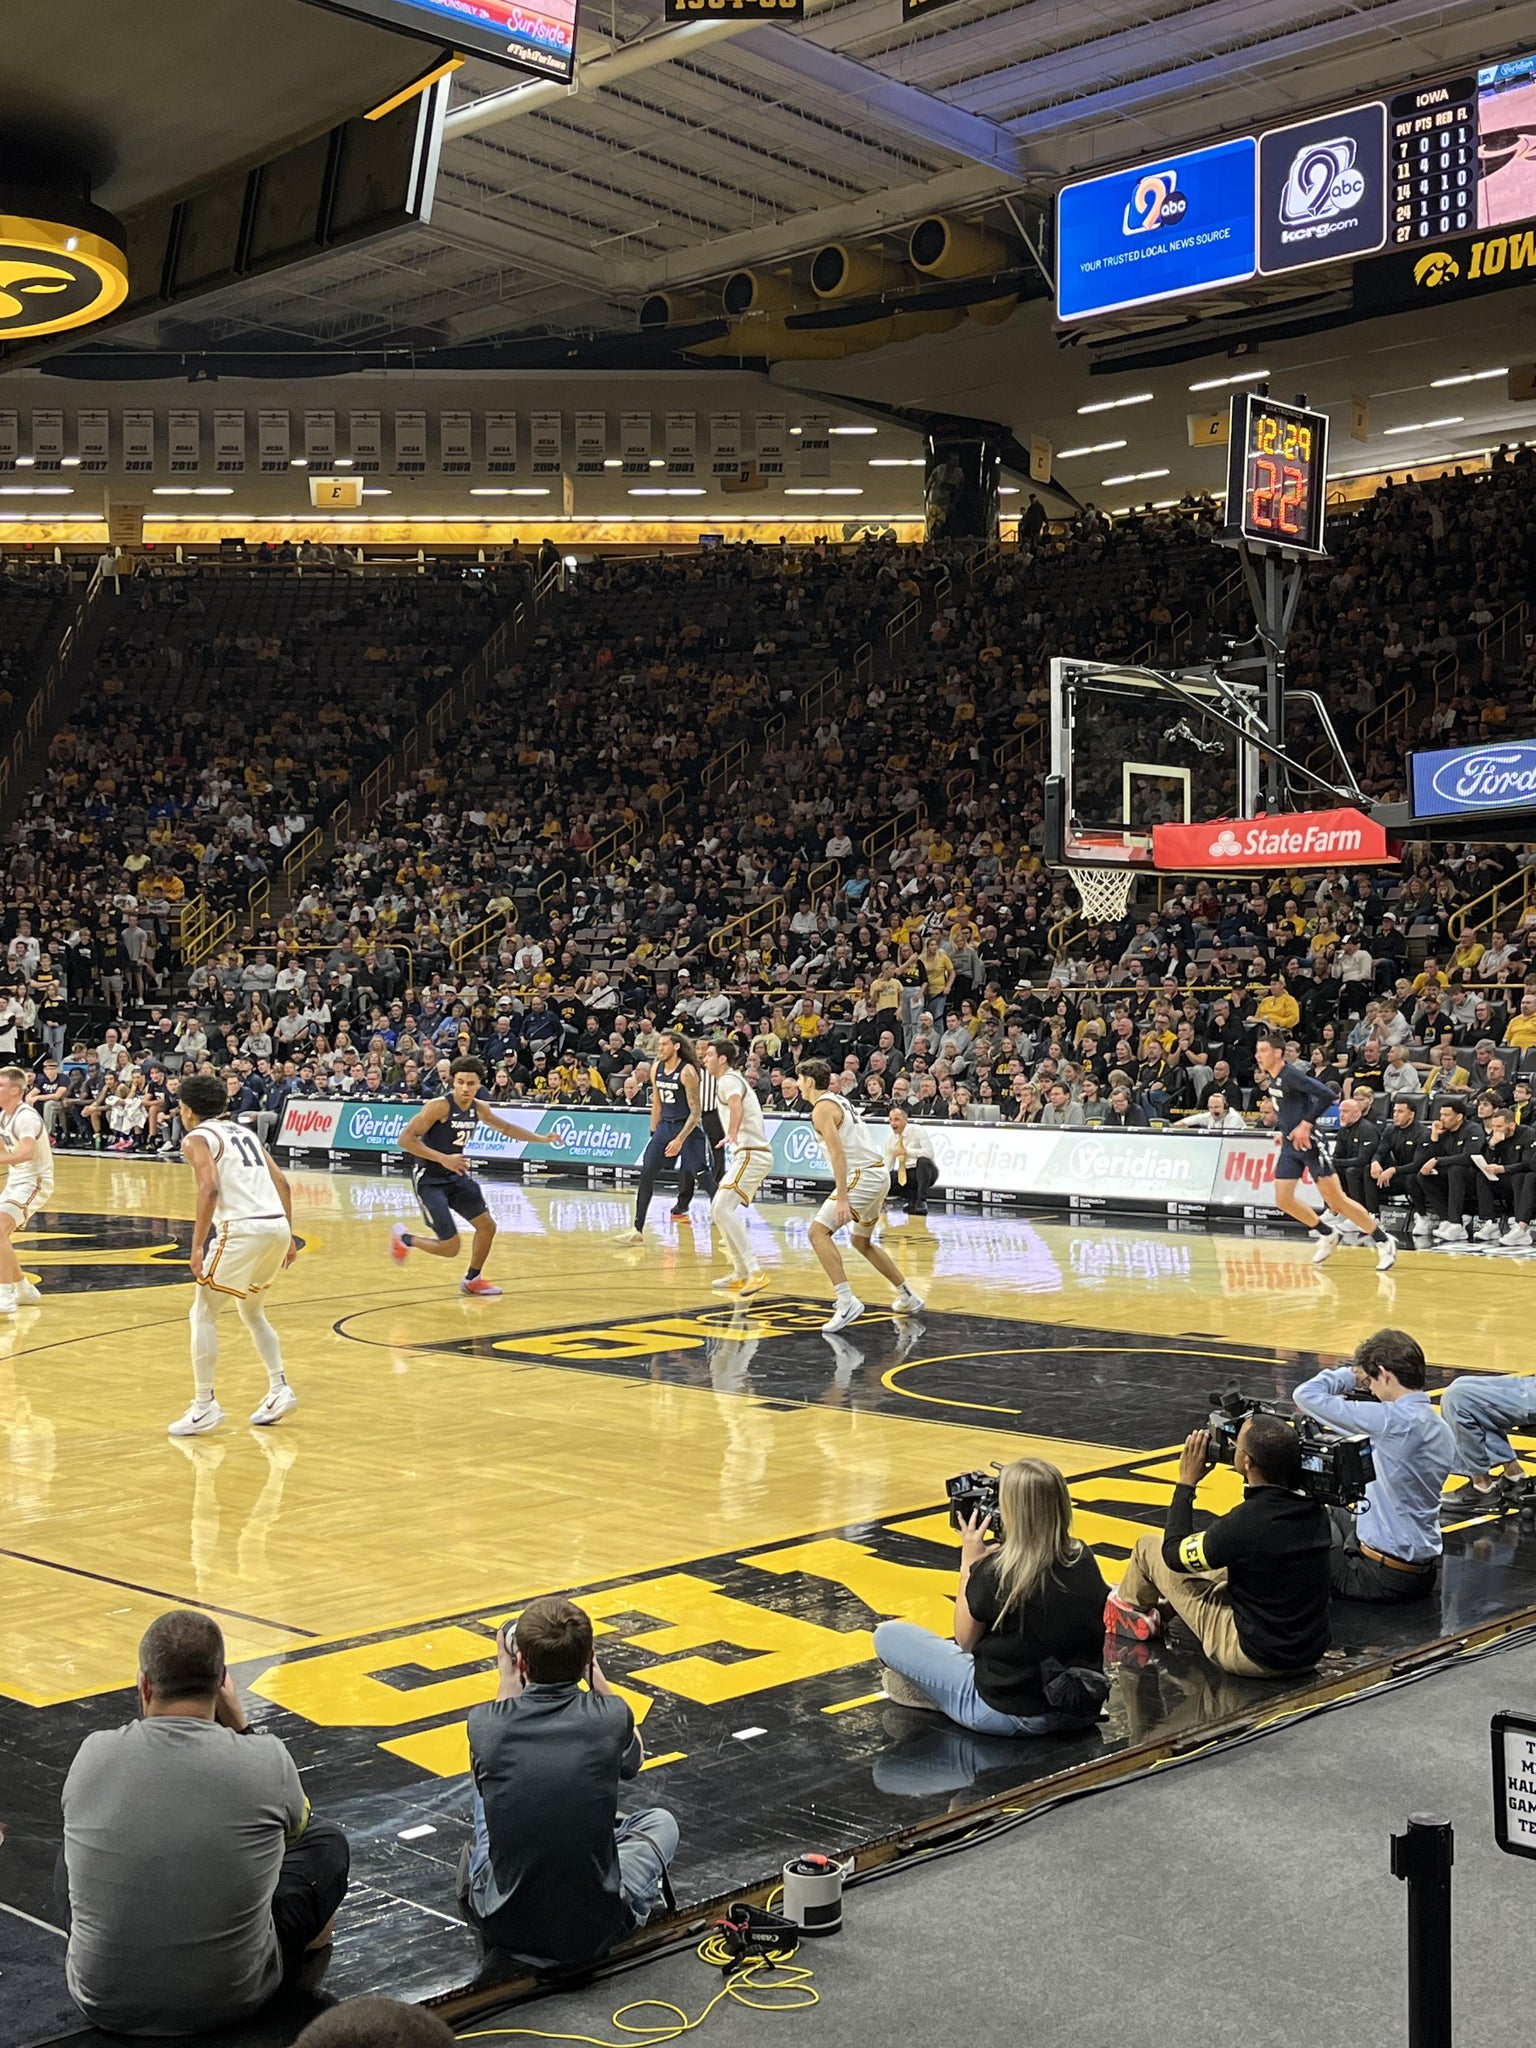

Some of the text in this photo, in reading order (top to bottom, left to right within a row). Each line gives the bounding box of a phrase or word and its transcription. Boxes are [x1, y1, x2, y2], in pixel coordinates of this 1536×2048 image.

[507, 8, 565, 44] Surfside
[1416, 88, 1449, 107] IOWA
[1396, 108, 1468, 137] PLY PTS REB FL
[1400, 128, 1466, 158] 7 0 0 1
[1397, 149, 1466, 179] 11 4 0 1
[1331, 180, 1362, 198] abc
[1397, 170, 1466, 201] 14 4 1 0
[1161, 199, 1186, 216] abc
[1396, 191, 1466, 222] 24 1 0 0
[1282, 218, 1358, 243] kcrg.com
[1397, 212, 1466, 243] 27 0 0 0
[1080, 228, 1231, 273] YOUR TRUSTED LOCAL NEWS SOURCE
[1210, 422, 1219, 435] C
[801, 440, 829, 448] IOWA
[1257, 416, 1311, 462] 12:29
[80, 461, 108, 470] 2017
[261, 461, 289, 471] 2012
[308, 461, 334, 471] 2011
[353, 461, 380, 471] 2010
[533, 462, 560, 472] 2004
[666, 462, 695, 472] 2001
[758, 462, 783, 472] 1991
[332, 486, 342, 498] E
[1252, 459, 1303, 534] 22
[659, 1088, 676, 1104] 12
[285, 1109, 333, 1137] HyVee
[450, 1120, 476, 1129] XAVIER
[452, 1130, 471, 1147] 21
[556, 1121, 632, 1150] Veridian
[230, 1136, 265, 1168] 11
[485, 1142, 505, 1151] UNION
[569, 1147, 614, 1158] CREDIT UNION
[1077, 1147, 1188, 1181] Veridian
